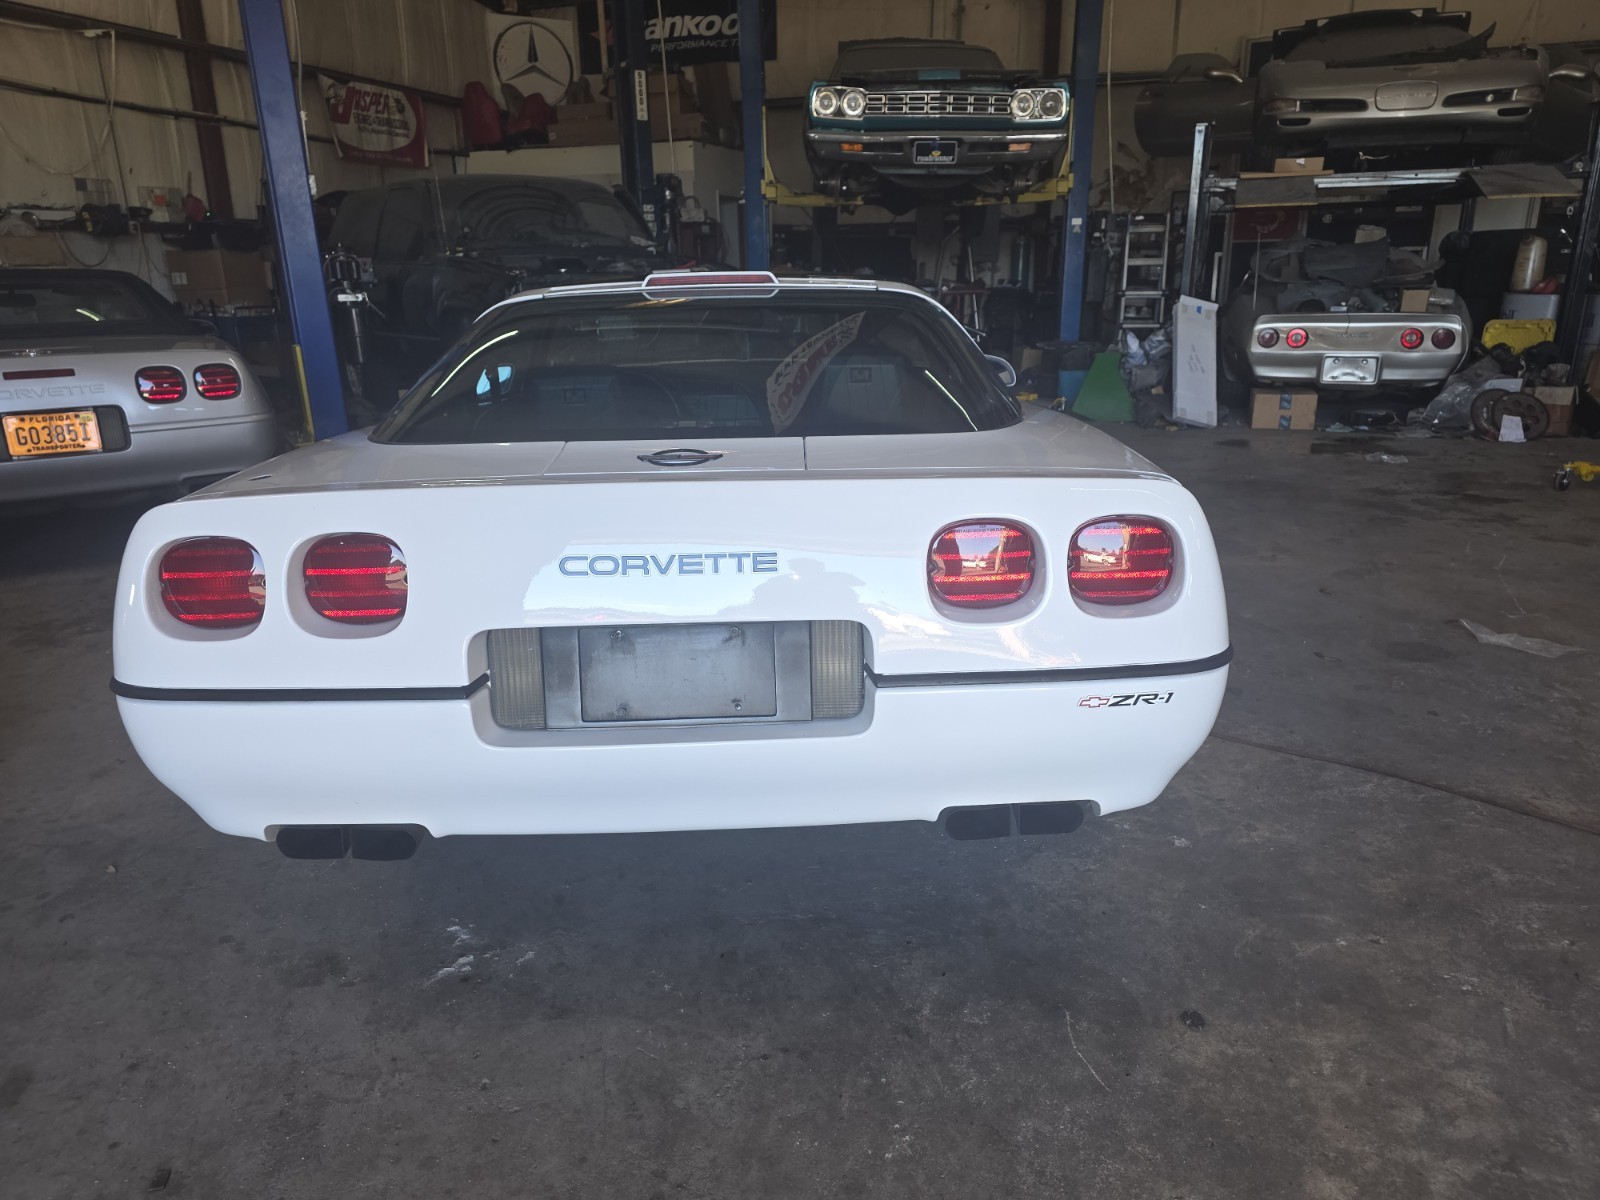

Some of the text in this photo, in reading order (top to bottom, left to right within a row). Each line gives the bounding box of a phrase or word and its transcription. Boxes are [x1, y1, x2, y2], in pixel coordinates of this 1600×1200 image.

[643, 13, 740, 40] ankoo
[651, 39, 728, 52] PERFORMANCE
[0, 383, 106, 400] ORVETTE
[29, 415, 71, 424] FLORIDA
[558, 551, 779, 577] CORVETTE
[1108, 691, 1174, 707] ZR-1
